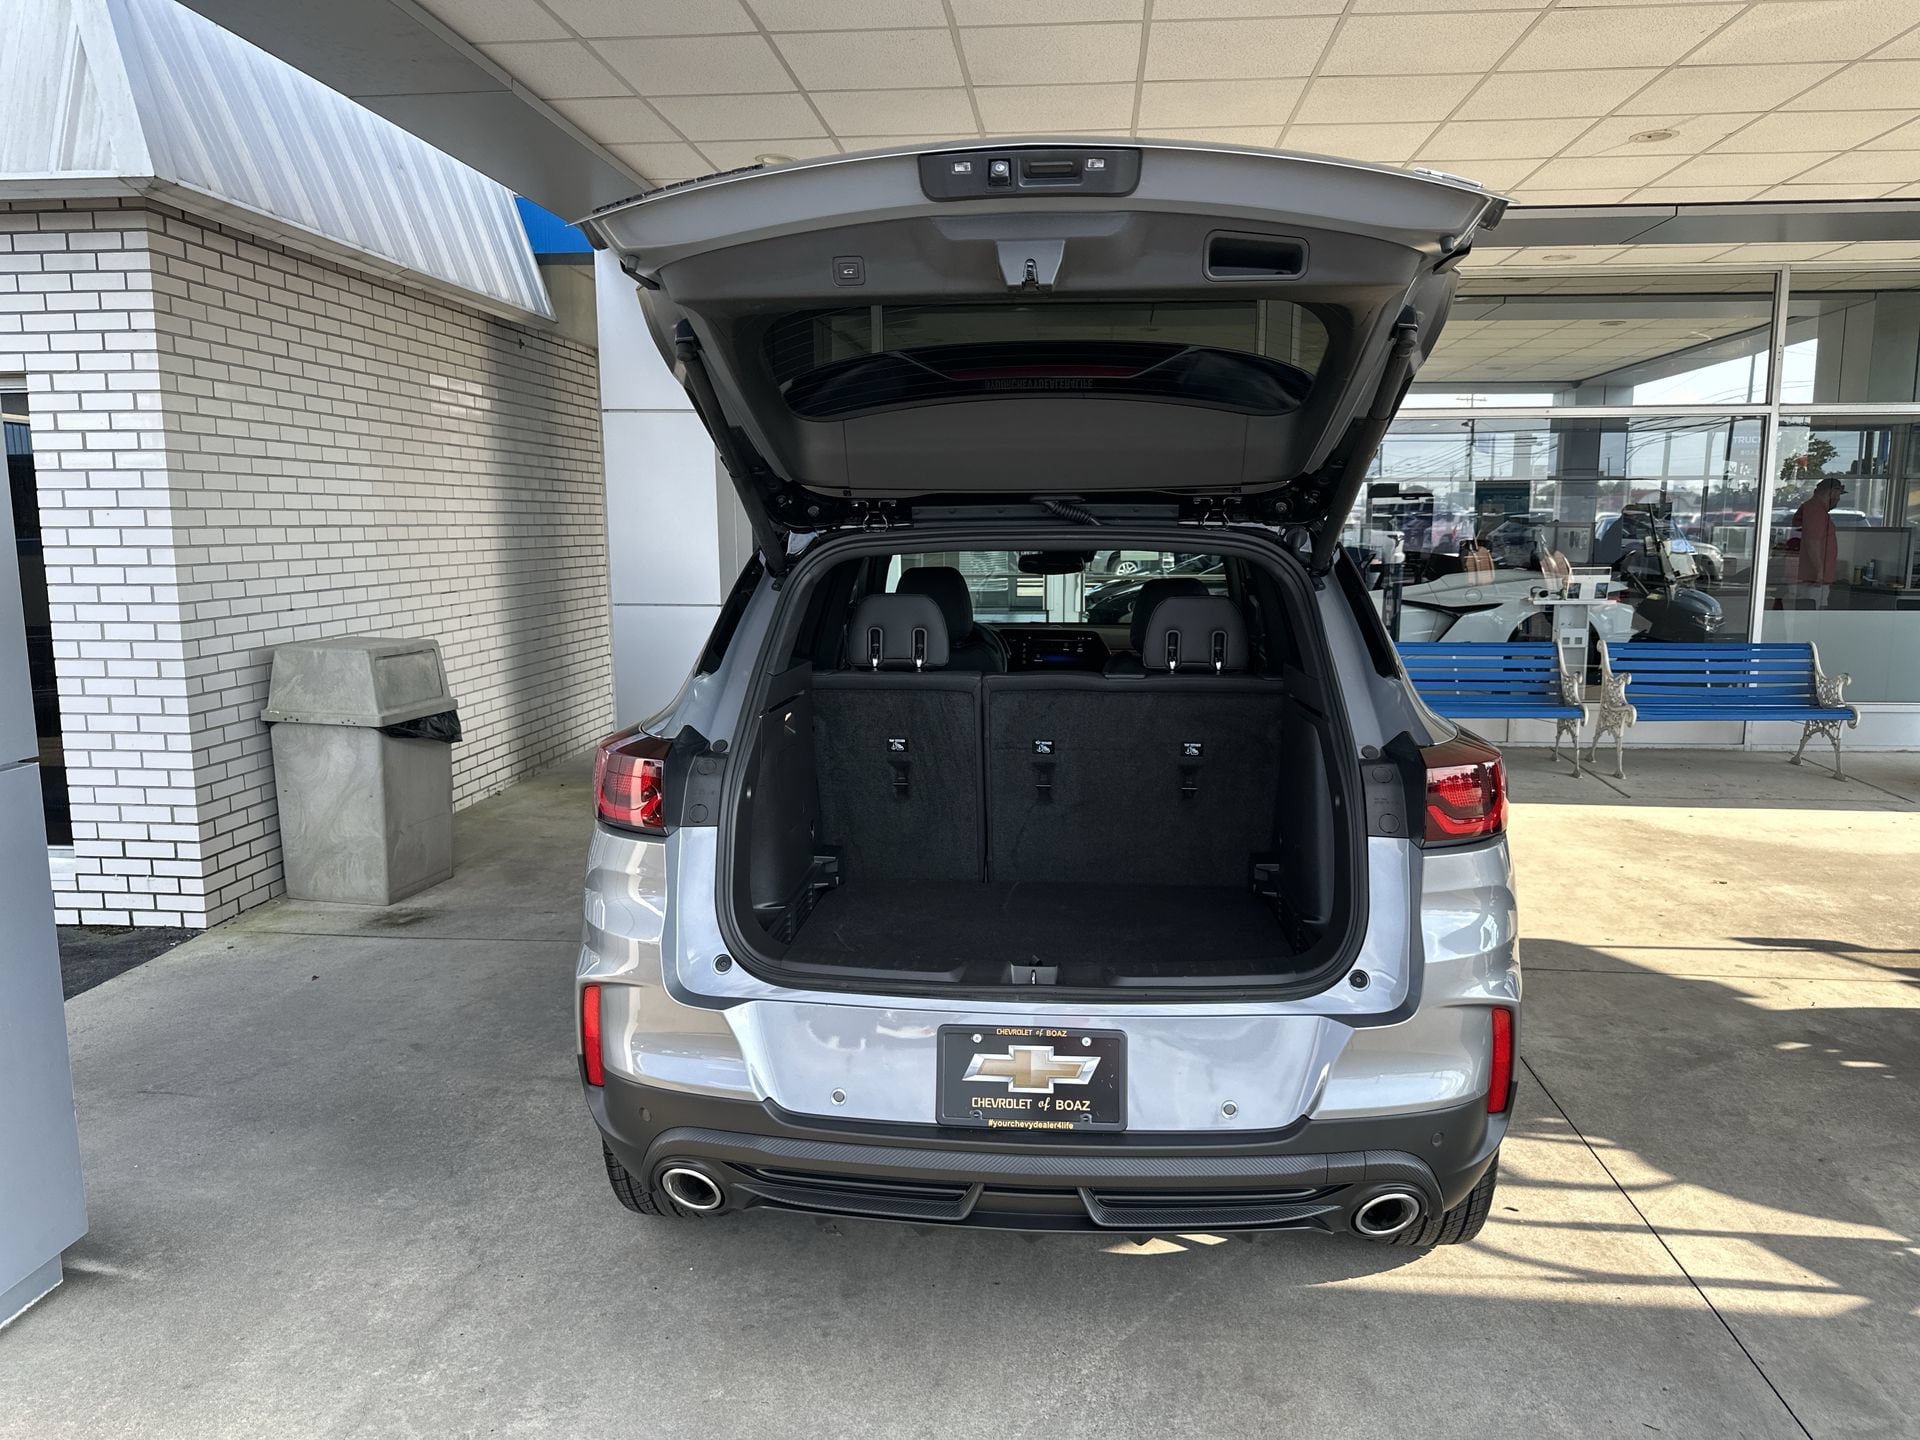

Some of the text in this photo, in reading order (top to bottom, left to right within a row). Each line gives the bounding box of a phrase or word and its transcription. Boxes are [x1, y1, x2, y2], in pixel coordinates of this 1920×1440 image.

[996, 1028, 1068, 1037] CHEVROLET of BOAZ
[971, 1097, 1091, 1111] CHEVROLET of BOAZ
[988, 1118, 1074, 1130] #yourchevydealer4life
